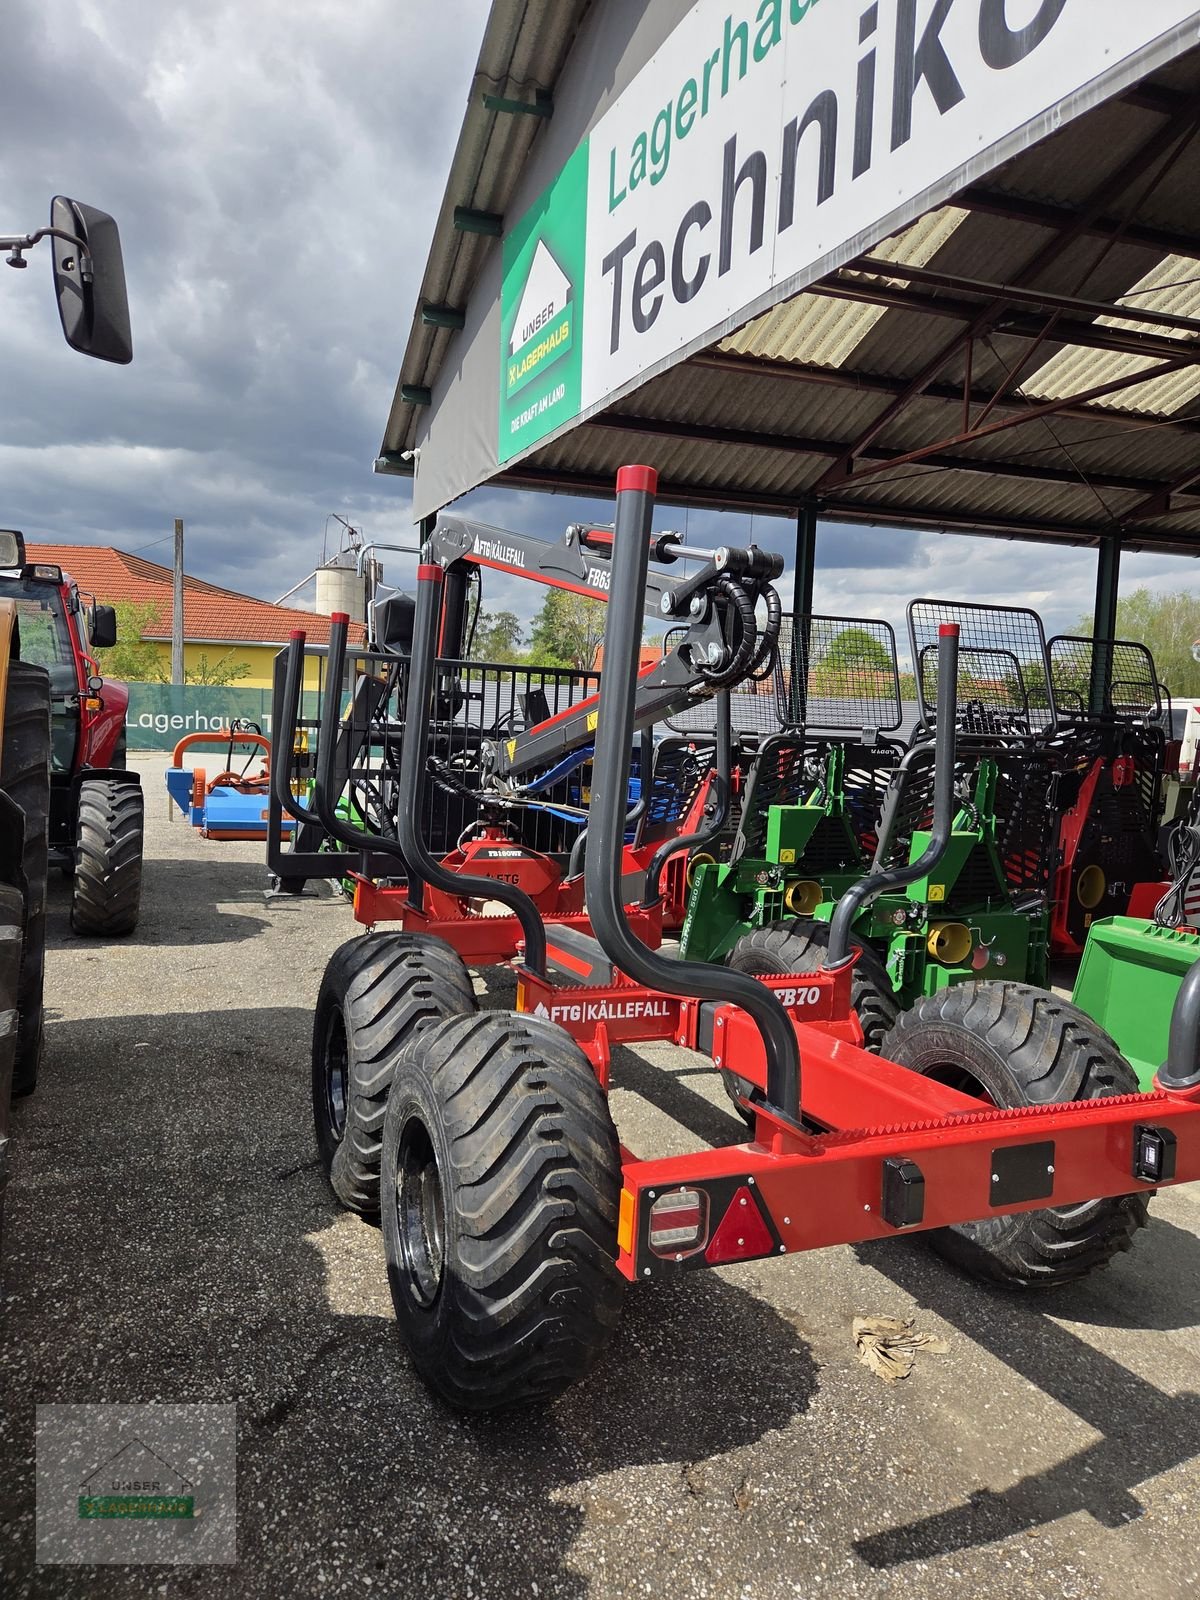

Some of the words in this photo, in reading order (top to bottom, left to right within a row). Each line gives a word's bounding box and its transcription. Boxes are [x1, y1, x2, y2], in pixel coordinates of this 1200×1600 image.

[608, 0, 821, 215] Lagerha
[522, 301, 554, 342] UNSER
[516, 320, 569, 380] LAGERHAUS
[511, 416, 519, 434] DIE
[519, 403, 538, 430] KRAFT
[538, 398, 548, 415] AM
[548, 383, 565, 409] LAND
[551, 1005, 581, 1022] FTG
[587, 1000, 670, 1020] KÄLLEFALL
